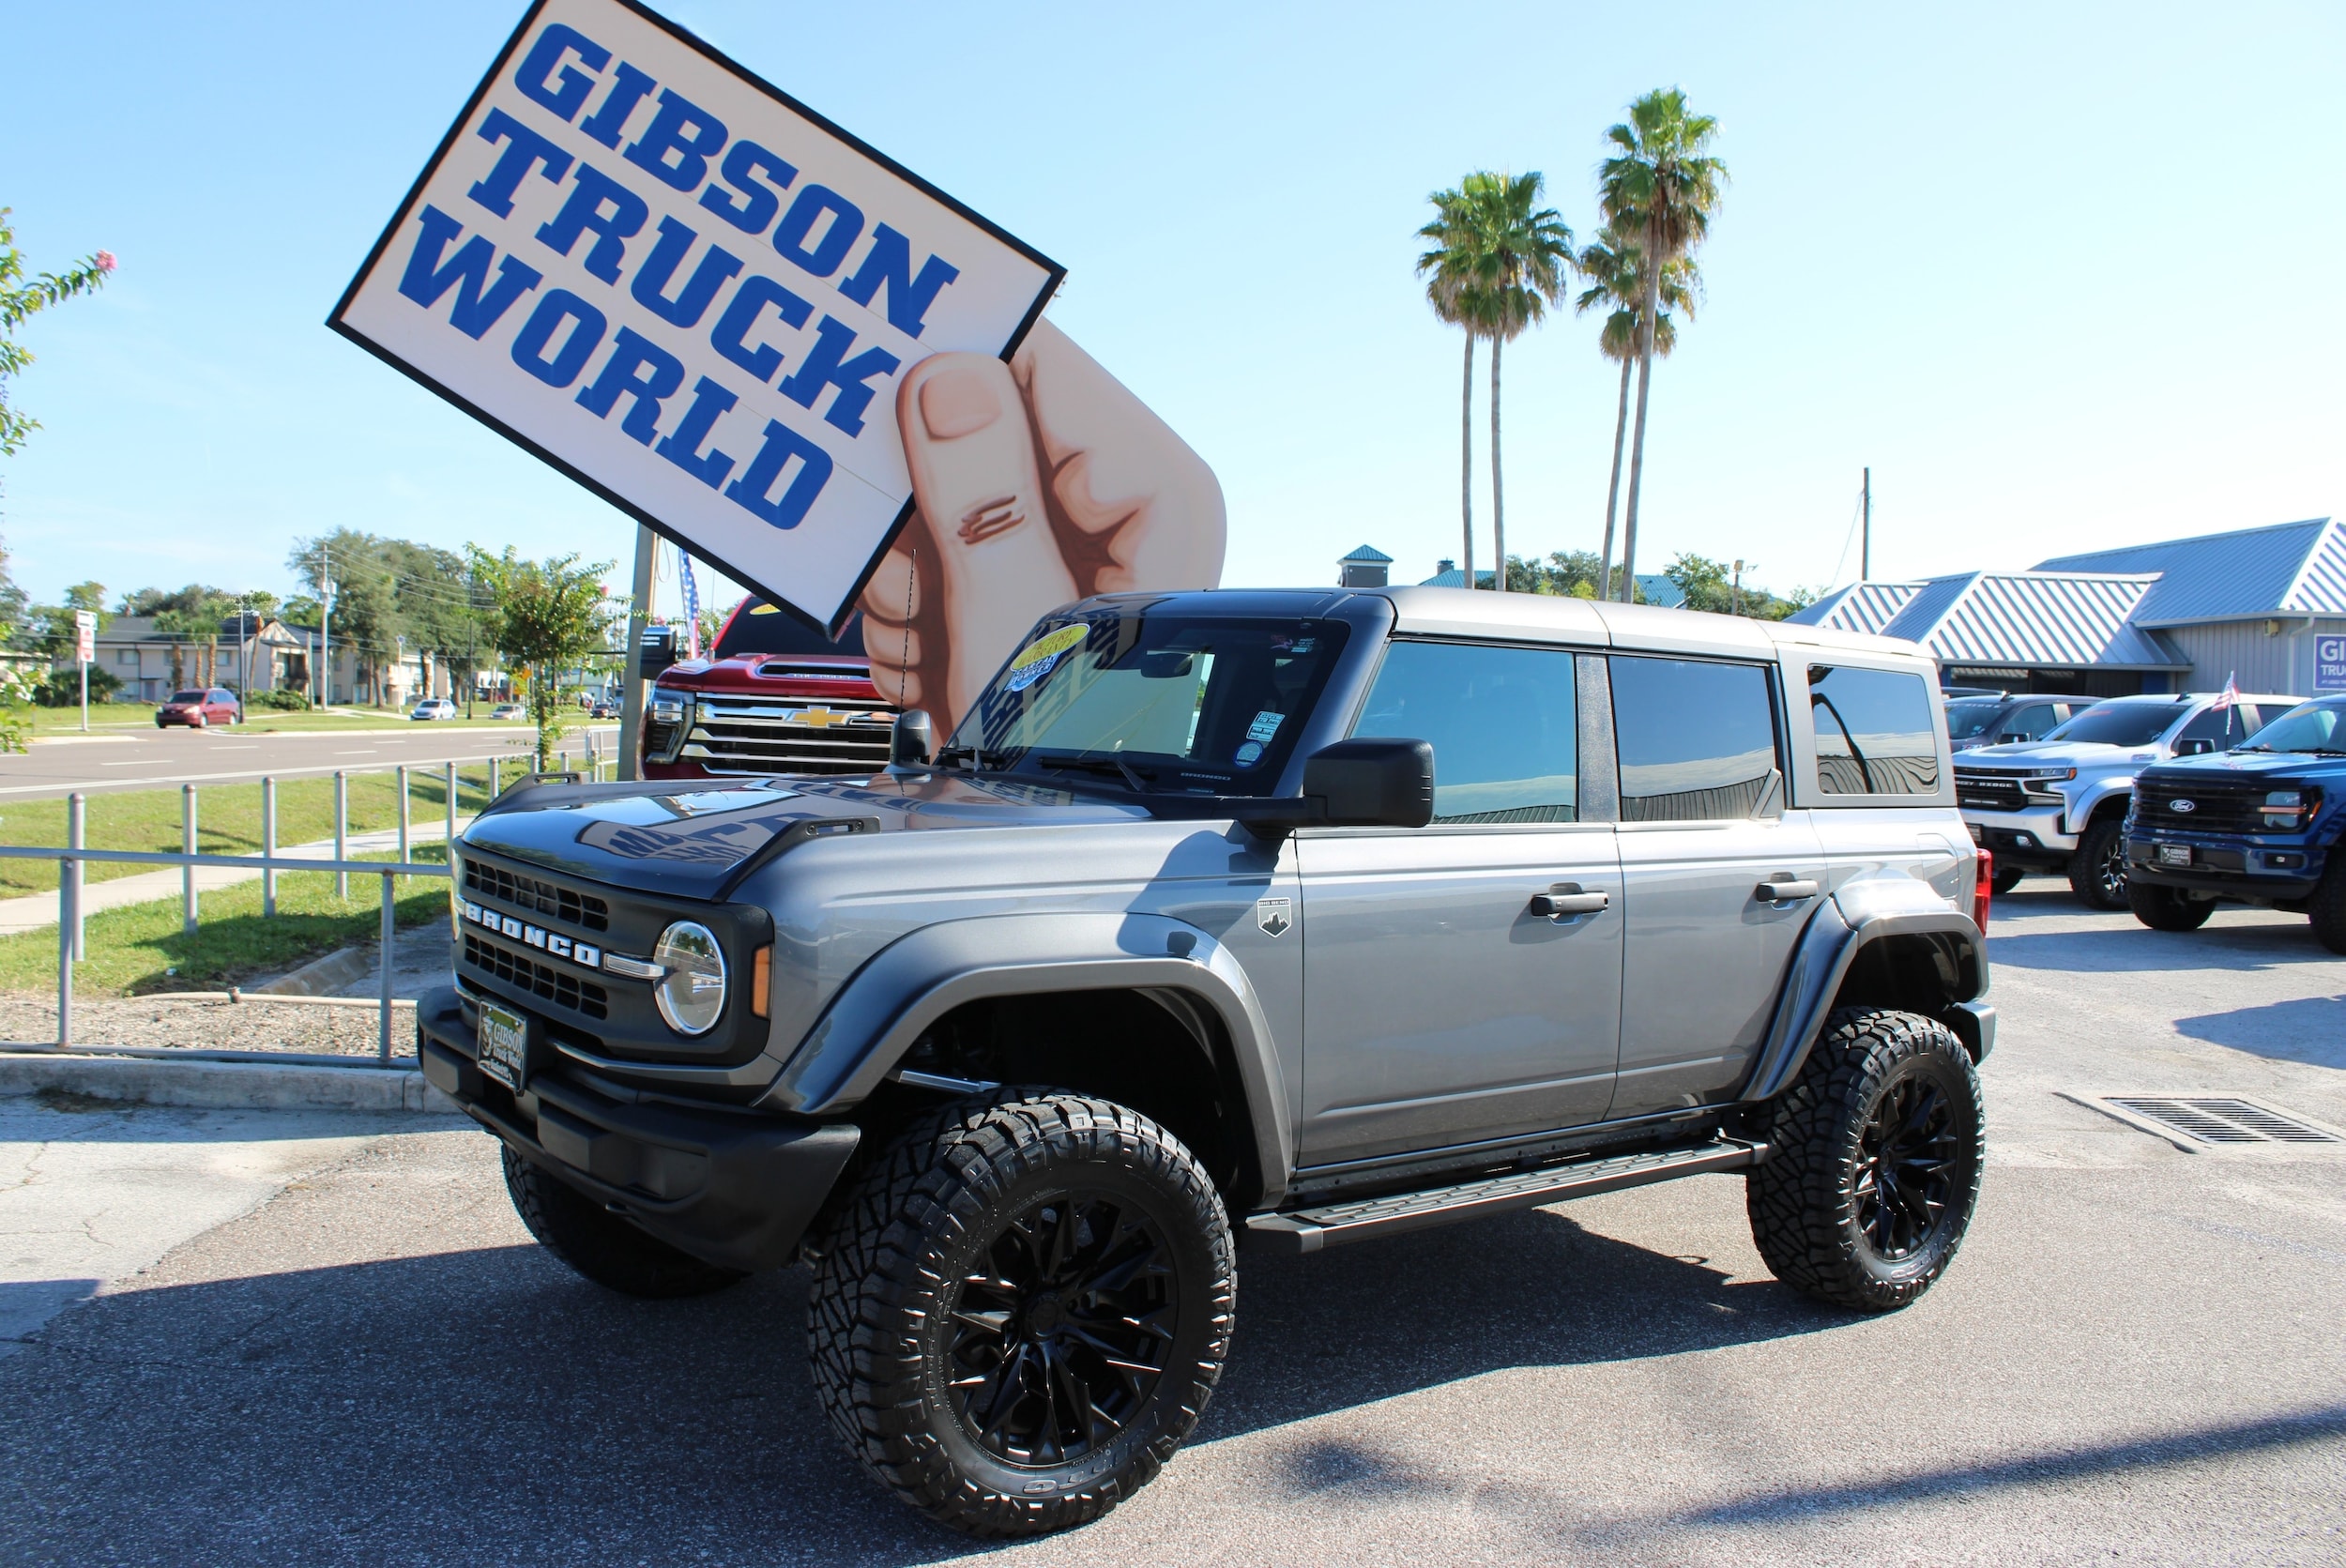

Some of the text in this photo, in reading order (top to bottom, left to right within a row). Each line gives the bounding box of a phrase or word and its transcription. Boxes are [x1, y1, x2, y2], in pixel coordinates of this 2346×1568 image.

[467, 107, 902, 438] TRUCK
[513, 23, 960, 339] GIBSON
[398, 203, 833, 530] WORLD
[2320, 664, 2346, 677] TRU
[465, 901, 600, 967] BRONCO
[494, 1022, 524, 1054] GIBSON
